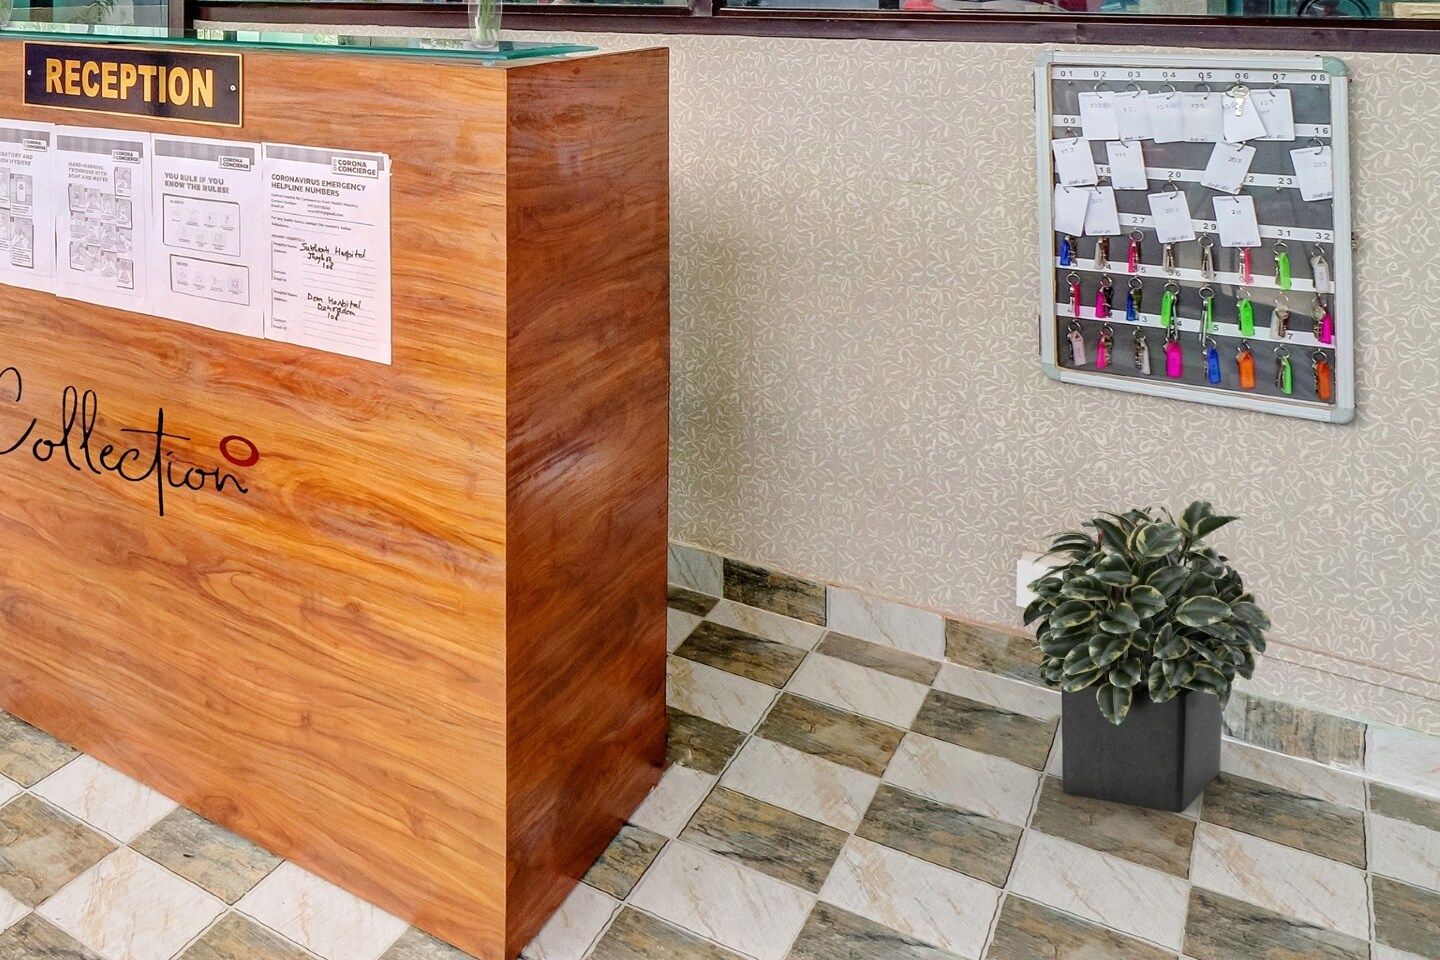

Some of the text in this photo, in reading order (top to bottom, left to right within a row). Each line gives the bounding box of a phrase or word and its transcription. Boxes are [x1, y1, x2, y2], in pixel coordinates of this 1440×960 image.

[46, 58, 214, 108] RECEPTION
[338, 159, 367, 168] CORONA
[338, 166, 376, 176] CONCIERGE
[164, 172, 179, 180] YOU
[180, 174, 198, 182] RULE
[208, 177, 224, 185] YOU
[271, 174, 366, 192] CORONAVIRUS EMERGENCY
[164, 180, 185, 189] KNOW
[186, 183, 201, 191] THE
[271, 182, 340, 197] HELPLINE NUMBERS
